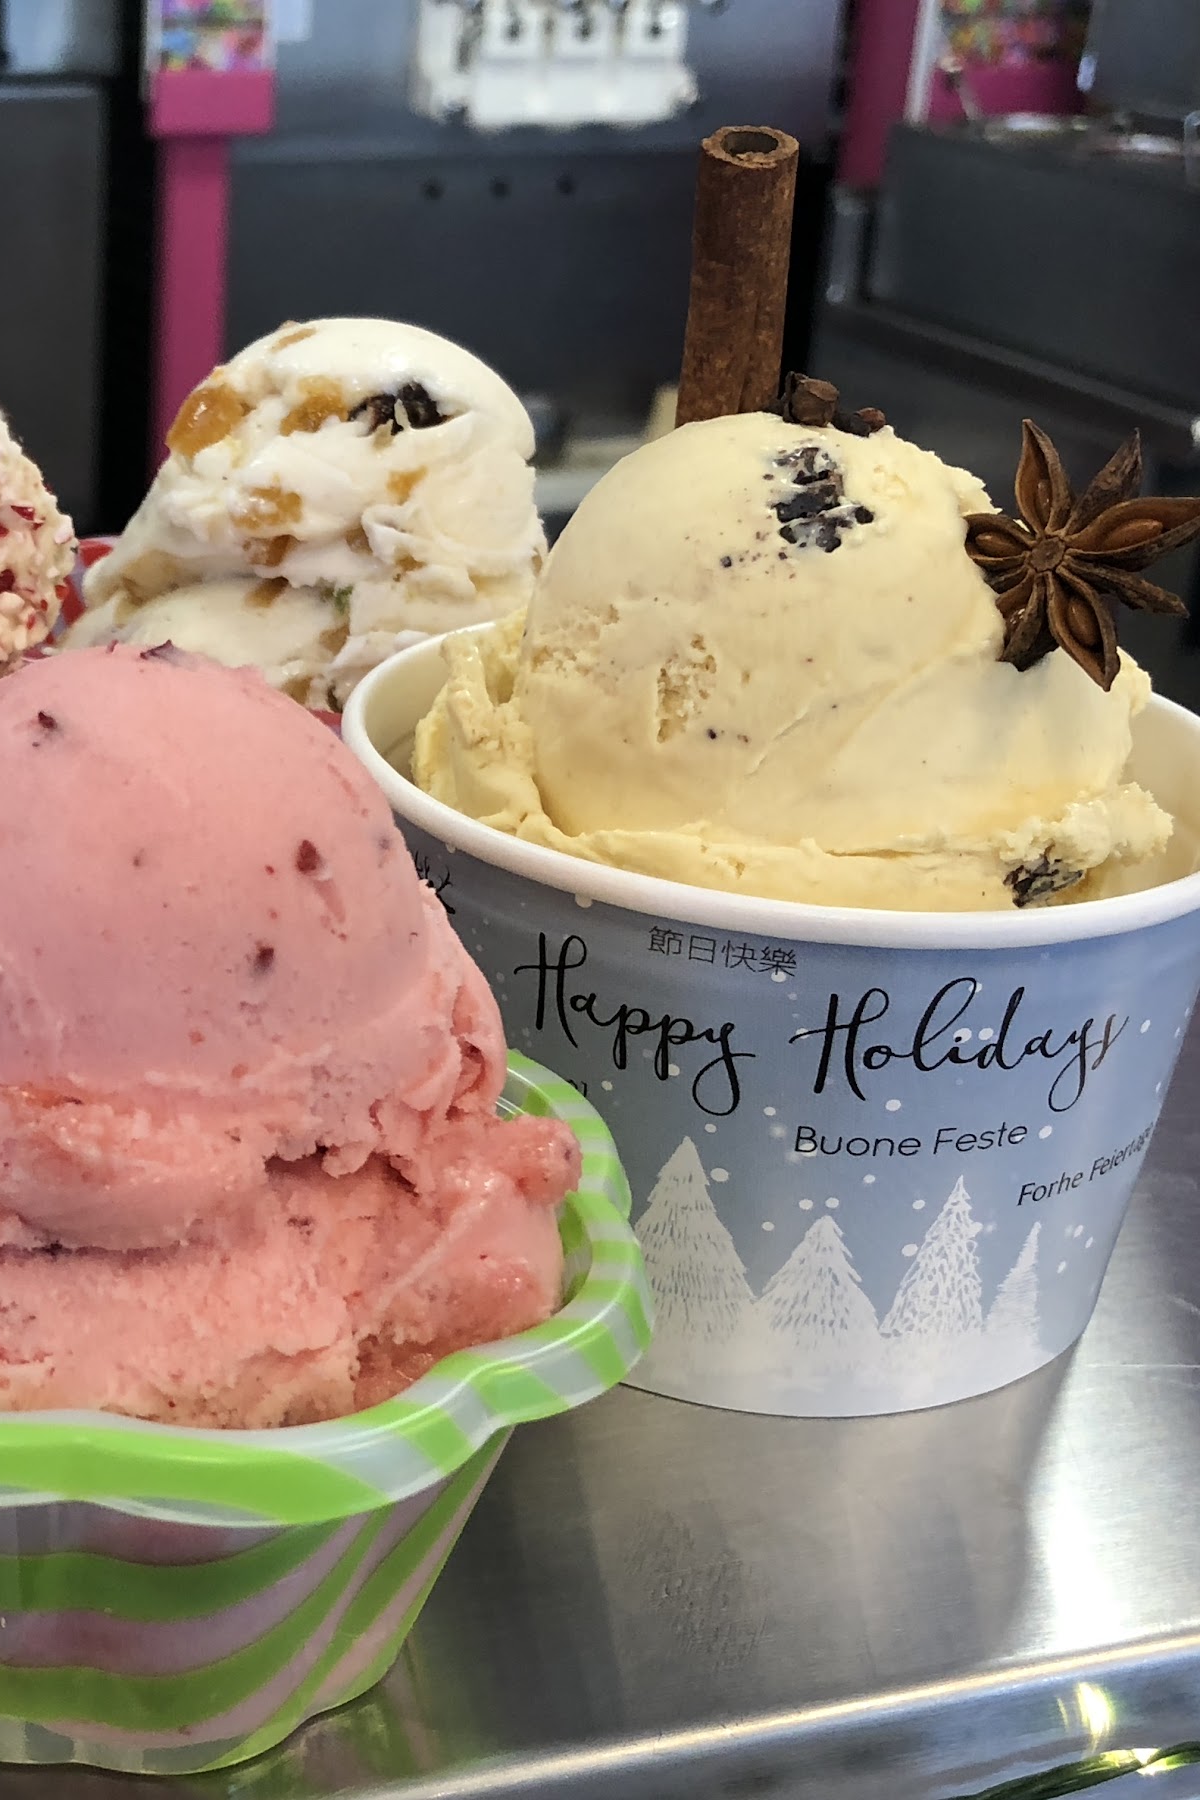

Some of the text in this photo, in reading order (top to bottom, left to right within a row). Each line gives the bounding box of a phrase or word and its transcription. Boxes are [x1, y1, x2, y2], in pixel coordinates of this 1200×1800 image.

[648, 925, 798, 977] 節日快樂
[513, 931, 1130, 1116] Happy Holidays
[794, 1121, 1028, 1157] Buone Feste
